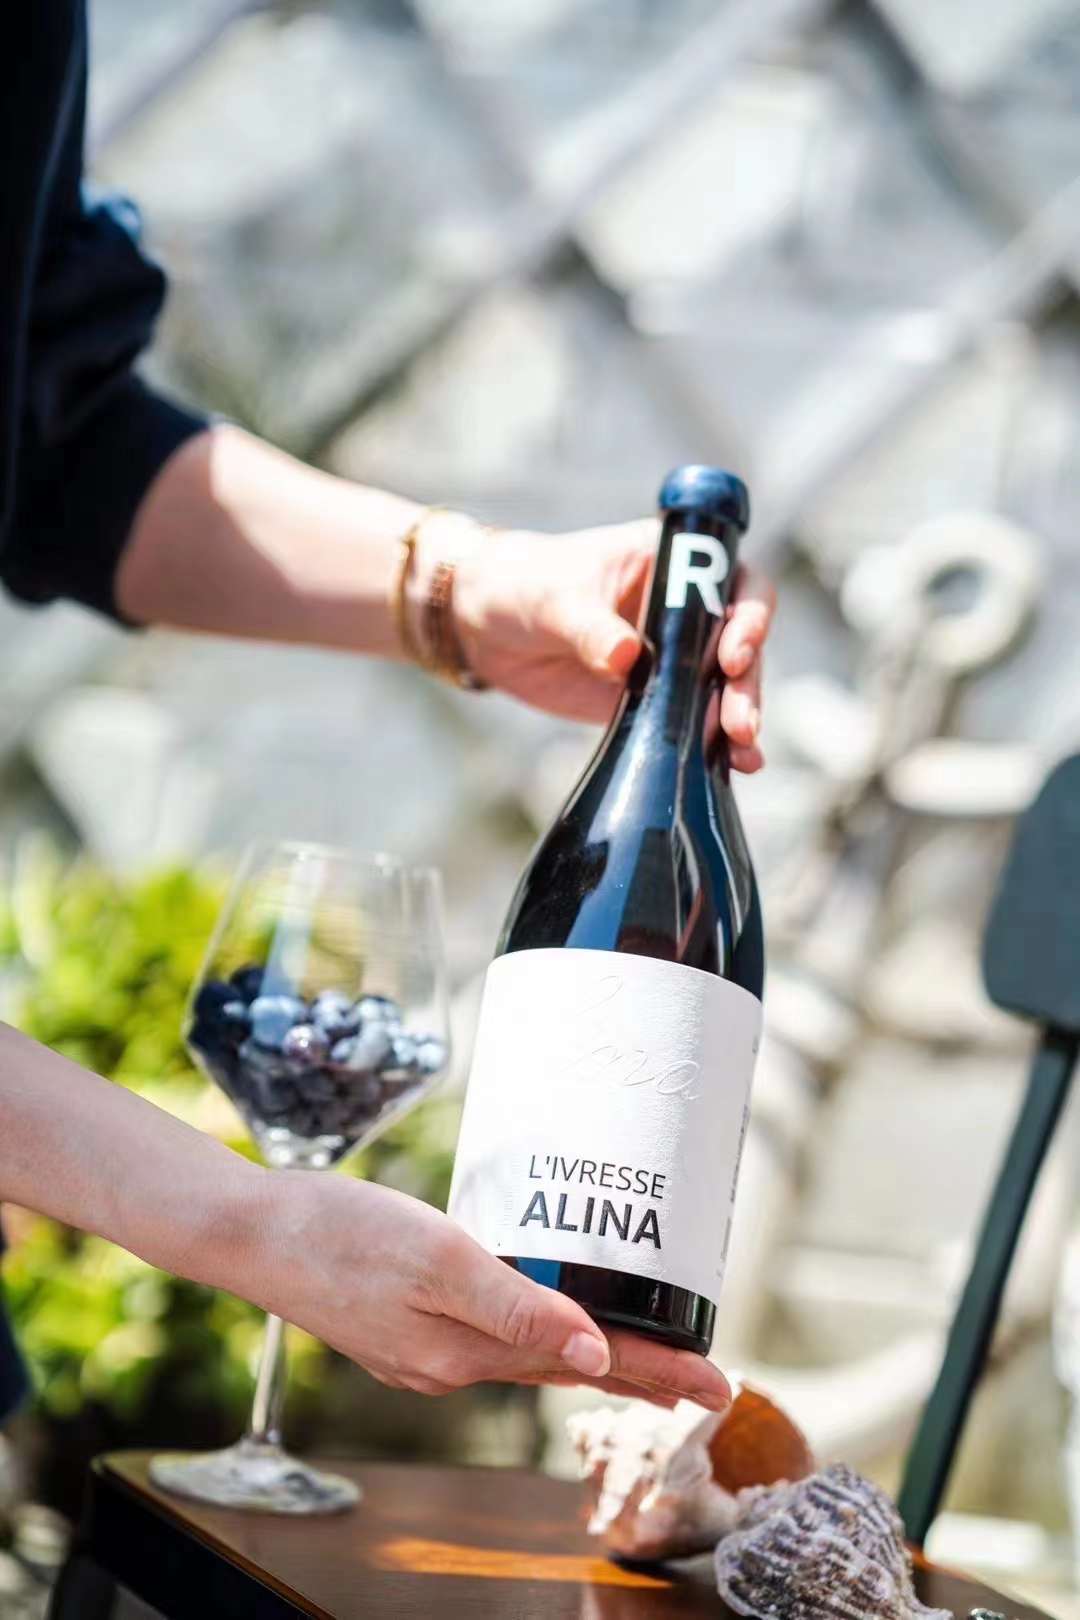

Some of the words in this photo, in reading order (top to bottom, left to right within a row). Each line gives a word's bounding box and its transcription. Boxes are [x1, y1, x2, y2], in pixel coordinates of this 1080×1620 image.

[665, 532, 729, 618] R
[528, 1154, 667, 1200] L'IVRESSE
[518, 1190, 662, 1250] ALINA
